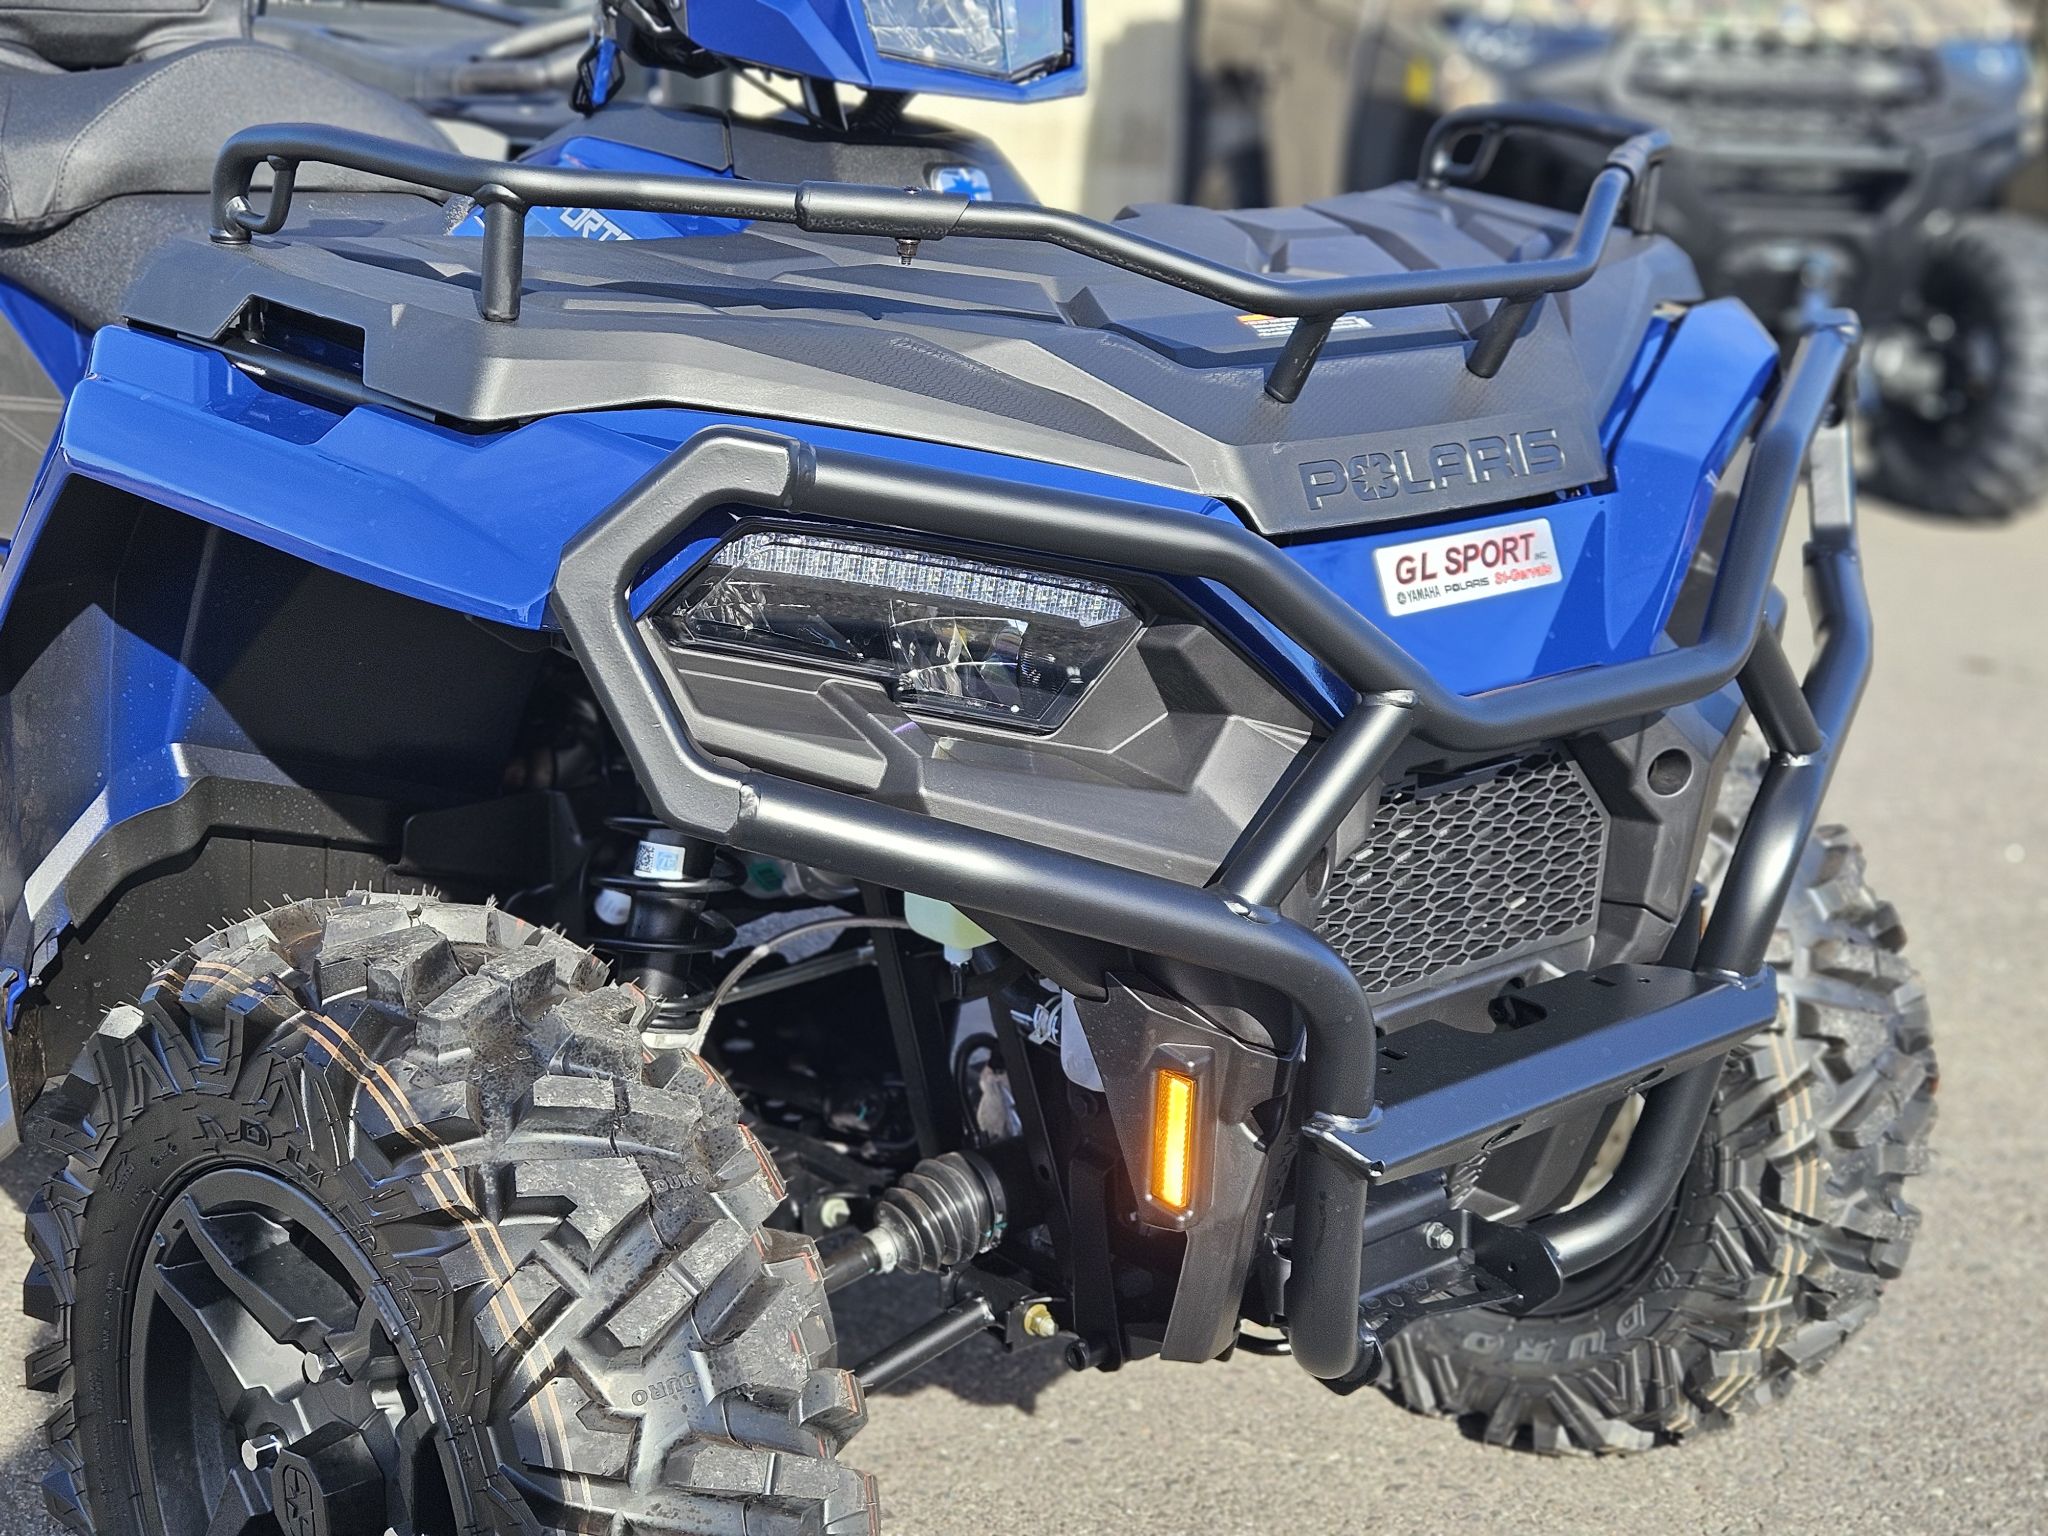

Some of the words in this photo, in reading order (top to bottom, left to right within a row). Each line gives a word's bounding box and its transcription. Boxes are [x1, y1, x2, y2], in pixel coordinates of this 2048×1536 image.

[1298, 428, 1566, 511] POLARIS
[1395, 551, 1438, 585] GL
[1443, 532, 1536, 576] SPORT
[1407, 584, 1442, 603] YAMAHA
[1444, 576, 1490, 594] POLARIS
[651, 1173, 702, 1194] DURO
[631, 1371, 696, 1407] DURO
